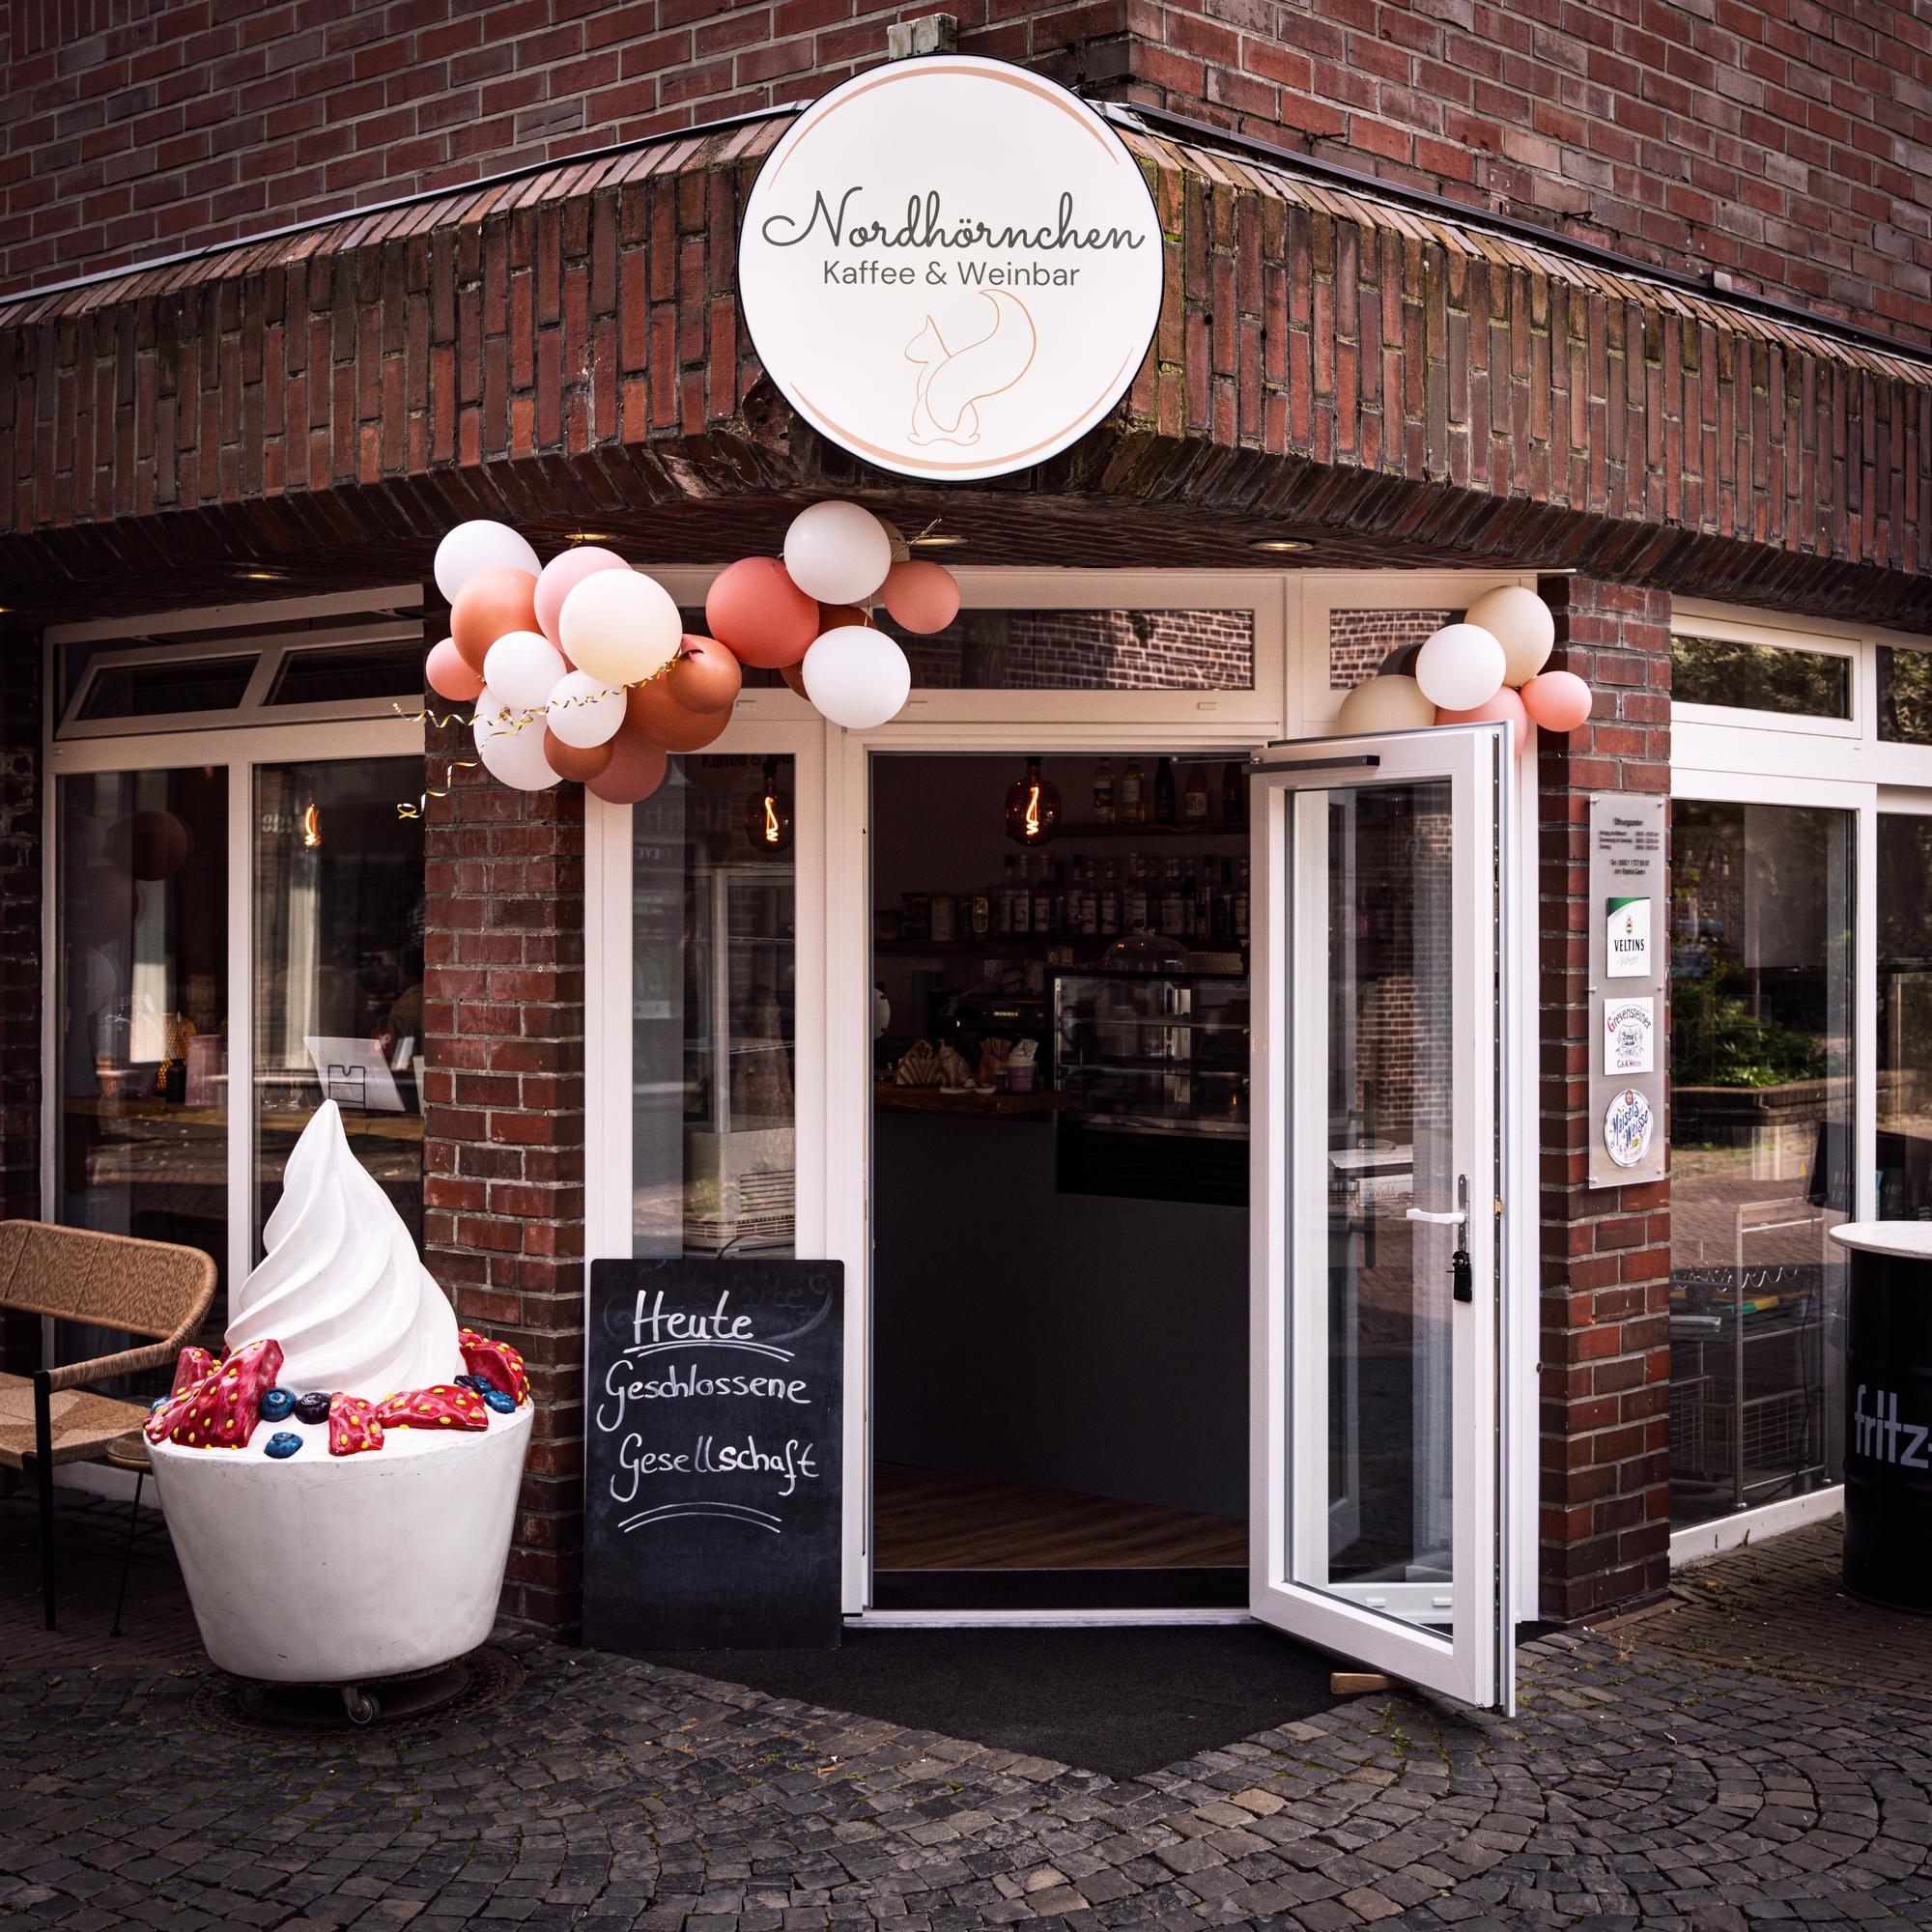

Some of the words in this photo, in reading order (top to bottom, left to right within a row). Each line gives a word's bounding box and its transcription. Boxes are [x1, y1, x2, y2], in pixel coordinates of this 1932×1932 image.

[761, 186, 1146, 250] Nordhörnchen
[823, 260, 916, 285] Kaffee
[924, 262, 948, 285] &
[957, 261, 1080, 287] Weinbar
[1614, 939, 1644, 952] VELTINS
[1606, 1008, 1652, 1033] Grevensteiner
[632, 1290, 754, 1344] Heute
[596, 1359, 811, 1432] Geschlossene
[610, 1433, 819, 1502] Gesellschaft
